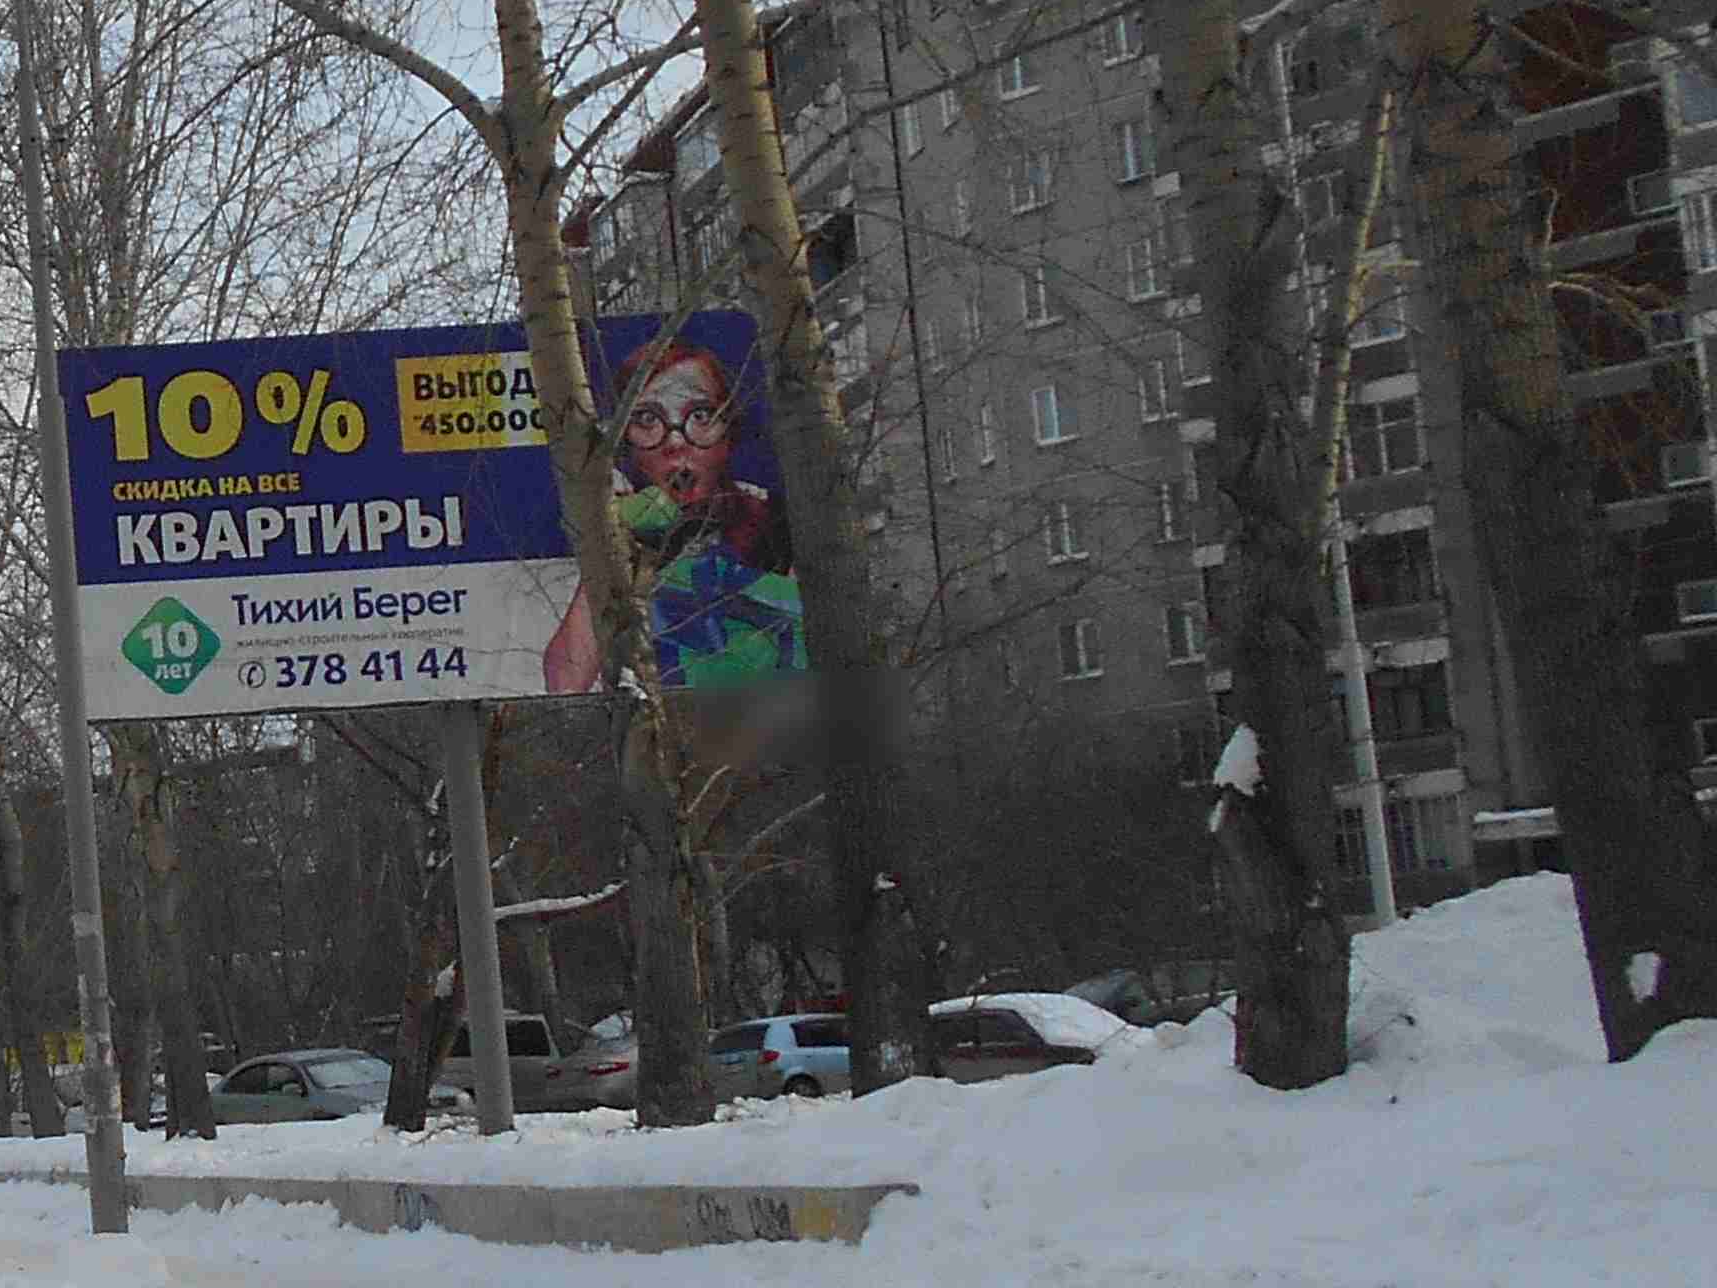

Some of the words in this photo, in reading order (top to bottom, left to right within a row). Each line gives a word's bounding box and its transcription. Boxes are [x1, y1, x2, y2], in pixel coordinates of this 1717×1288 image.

[113, 478, 213, 502] СКИДКА
[219, 475, 253, 495] НА
[258, 472, 301, 493] ВСЕ
[117, 496, 464, 565] КВАРТИРЫ
[232, 593, 343, 625] Тихий
[352, 587, 467, 624] Берег
[141, 621, 198, 658] 10
[155, 662, 192, 681] лет
[275, 653, 347, 688] 378
[360, 650, 403, 682] 41
[416, 647, 467, 679] 44
